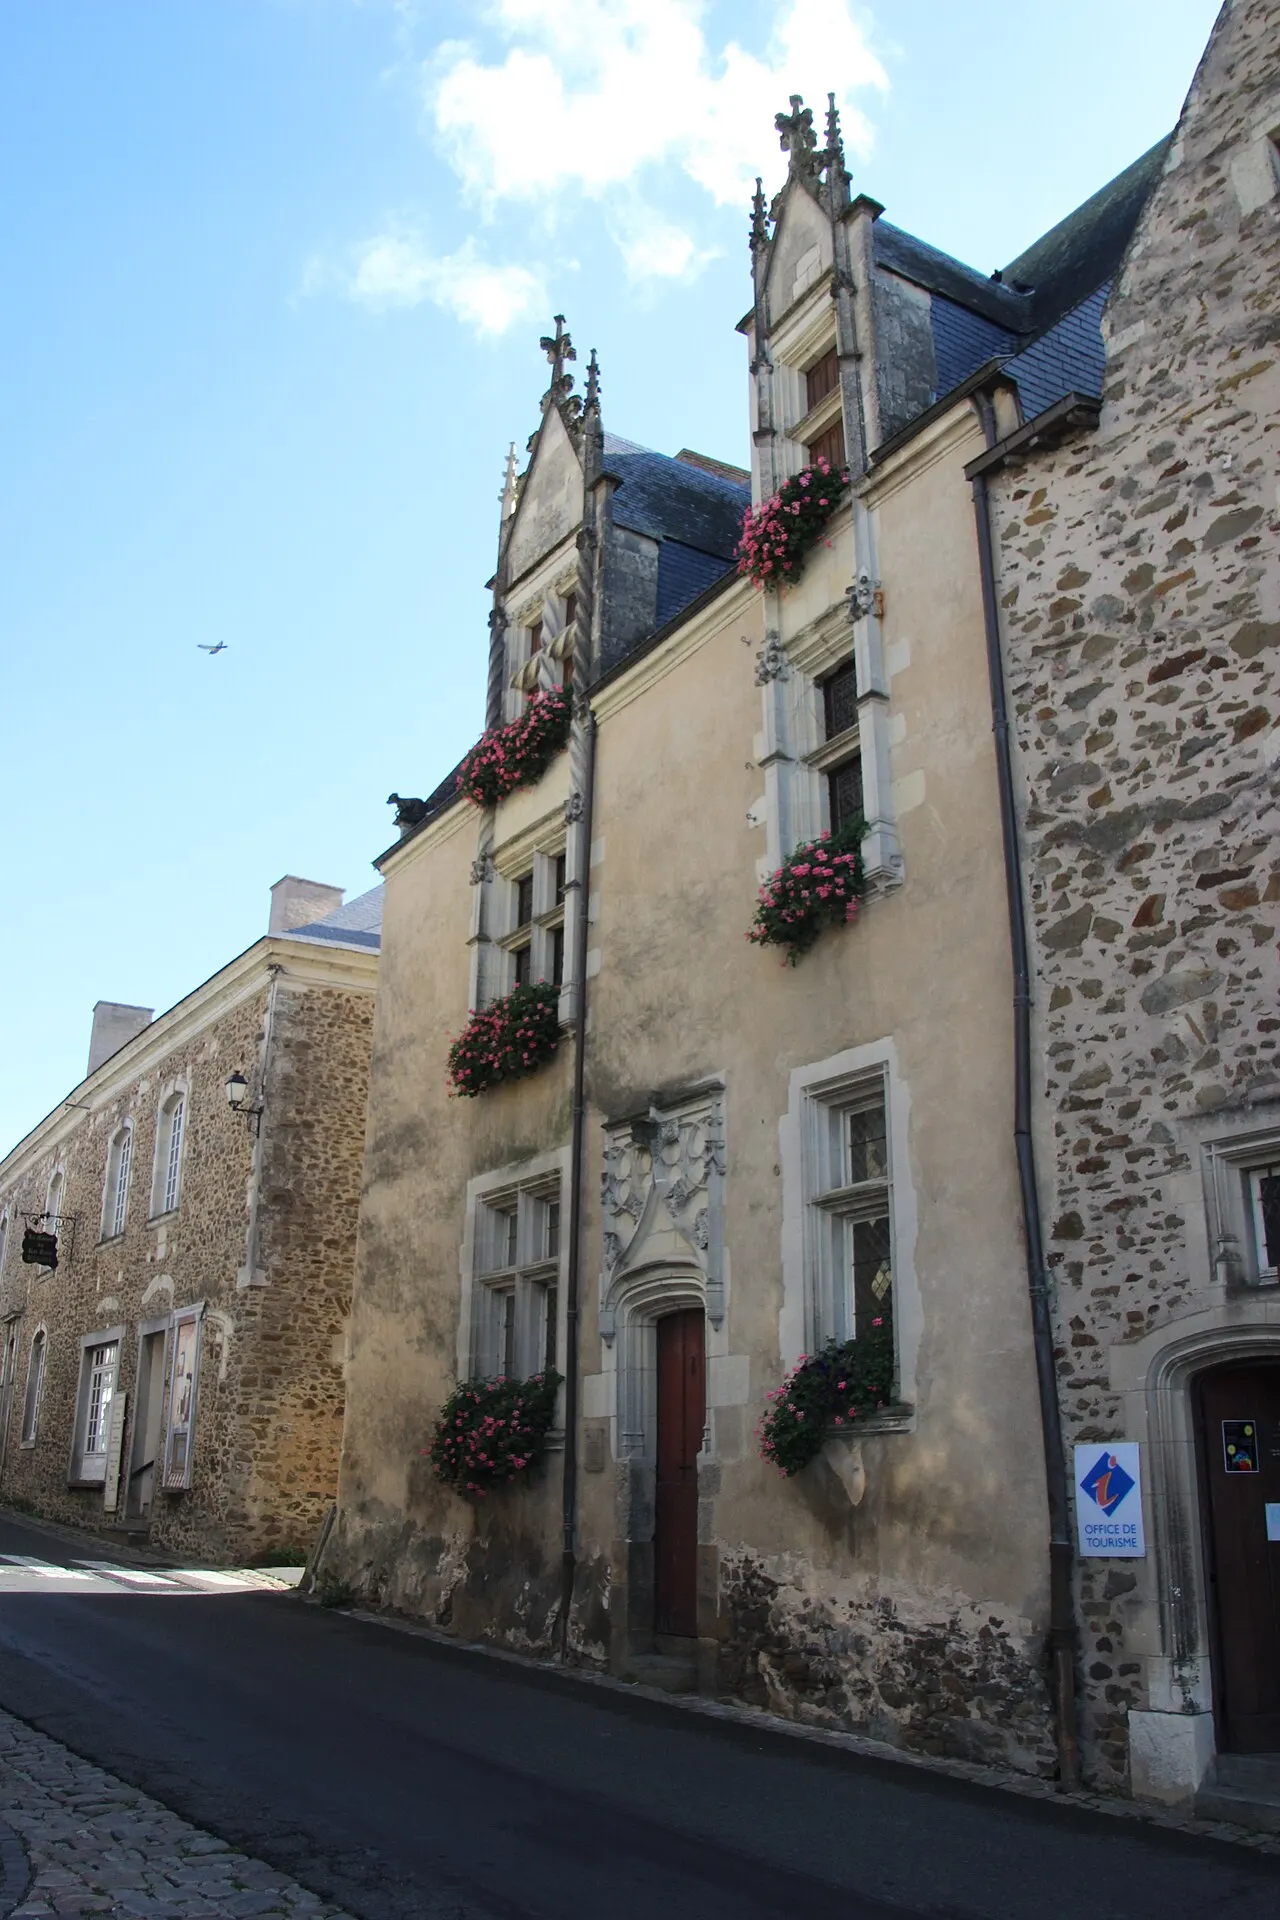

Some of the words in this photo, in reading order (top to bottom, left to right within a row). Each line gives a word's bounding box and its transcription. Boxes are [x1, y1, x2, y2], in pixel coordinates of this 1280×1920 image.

[1084, 1524, 1120, 1535] OFFICE
[1122, 1523, 1137, 1534] DE
[1086, 1537, 1137, 1548] TOURISME
